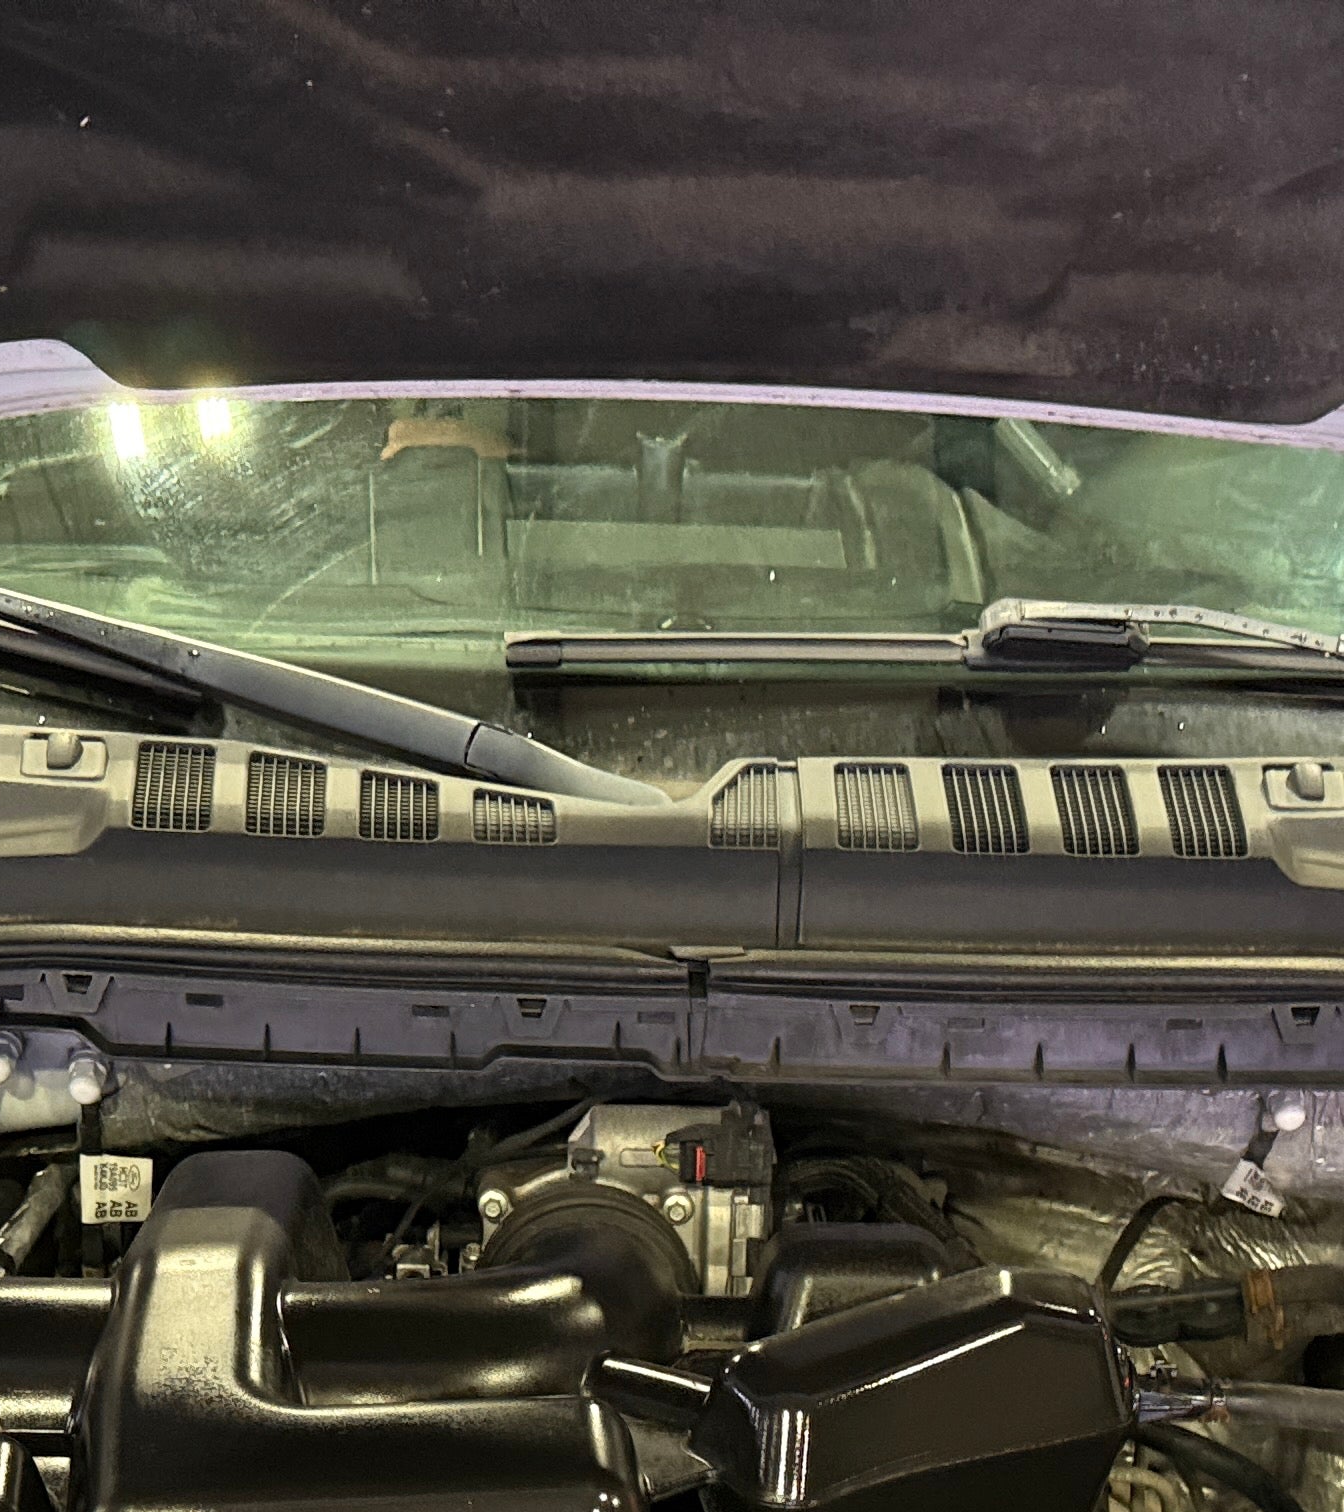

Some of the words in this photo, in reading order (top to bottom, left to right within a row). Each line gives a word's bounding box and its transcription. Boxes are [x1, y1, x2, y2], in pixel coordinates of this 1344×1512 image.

[95, 1202, 107, 1218] AB
[110, 1200, 122, 1217] AB
[125, 1201, 138, 1217] AB
